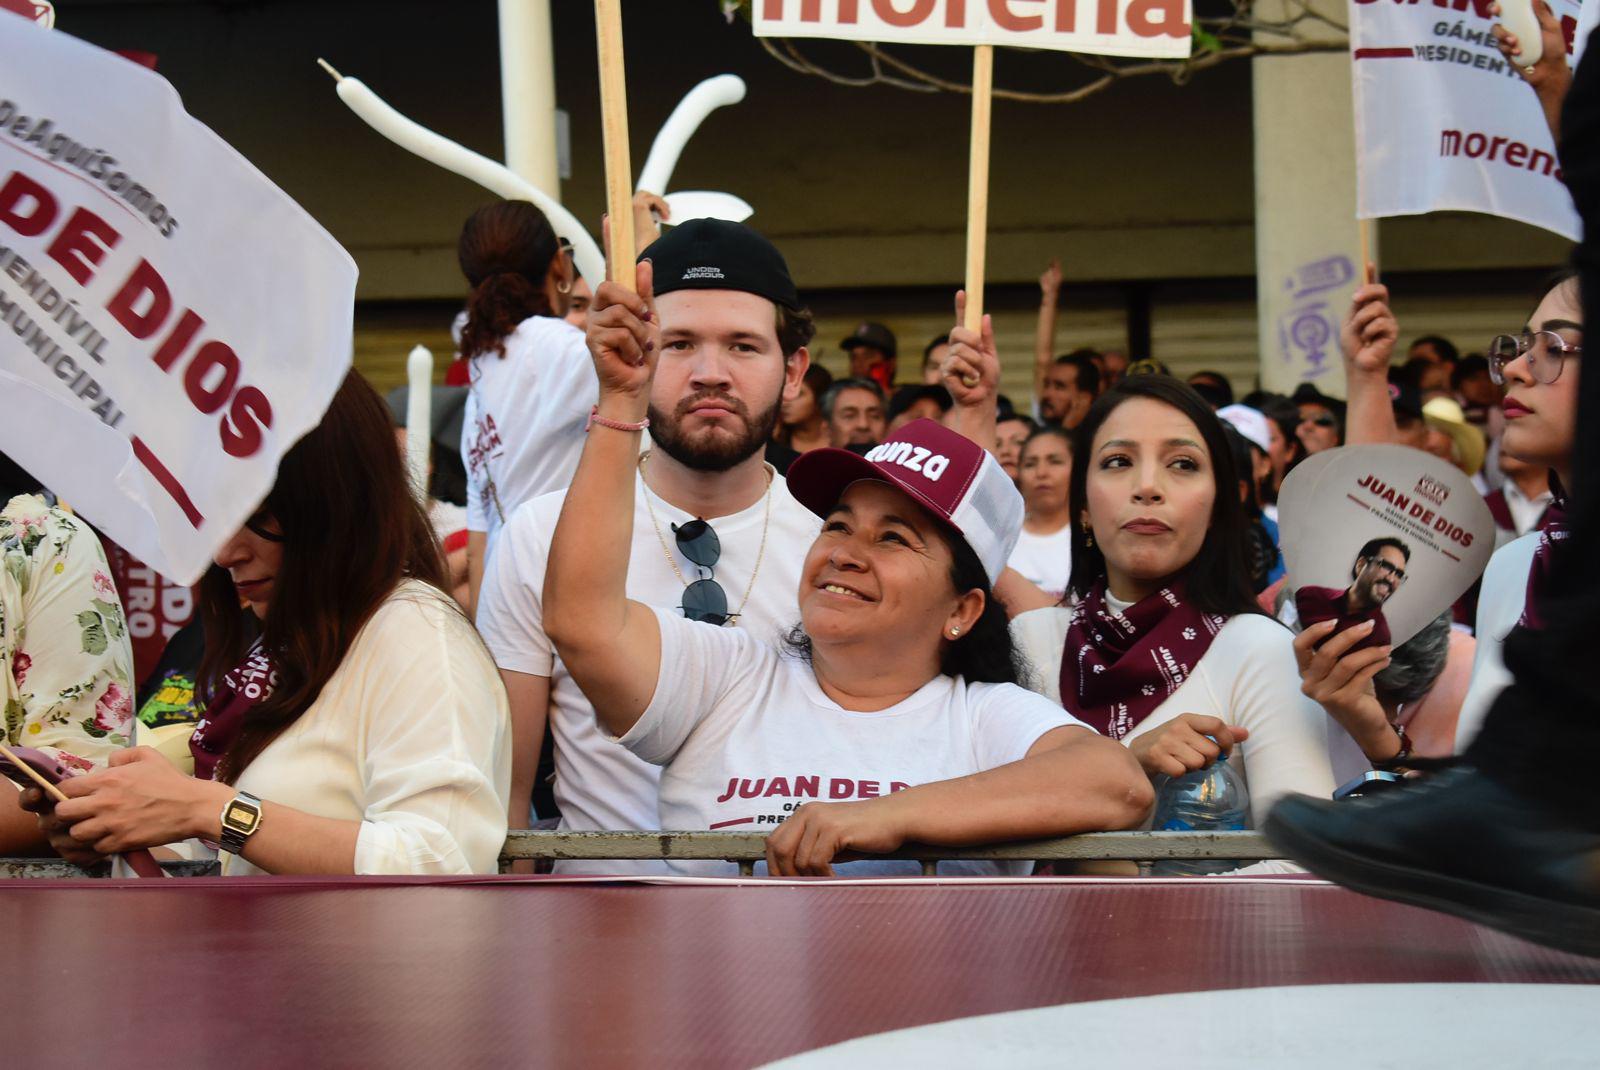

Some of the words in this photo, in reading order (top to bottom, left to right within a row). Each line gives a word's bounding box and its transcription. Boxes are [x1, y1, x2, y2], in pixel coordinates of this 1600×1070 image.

[1433, 20, 1498, 48] GÁME
[1415, 44, 1524, 81] ESIDEN
[1440, 128, 1564, 182] moren
[682, 272, 725, 280] ARMOUR
[0, 170, 123, 288] DE
[105, 256, 273, 458] DIOS
[864, 441, 950, 482] unza
[1357, 474, 1411, 511] JUAN
[1408, 501, 1436, 526] DE
[1433, 516, 1474, 548] DIOS
[1113, 611, 1136, 634] DIOS
[1159, 646, 1180, 675] JUAN
[717, 775, 820, 803] JUAN
[829, 778, 880, 799] DE
